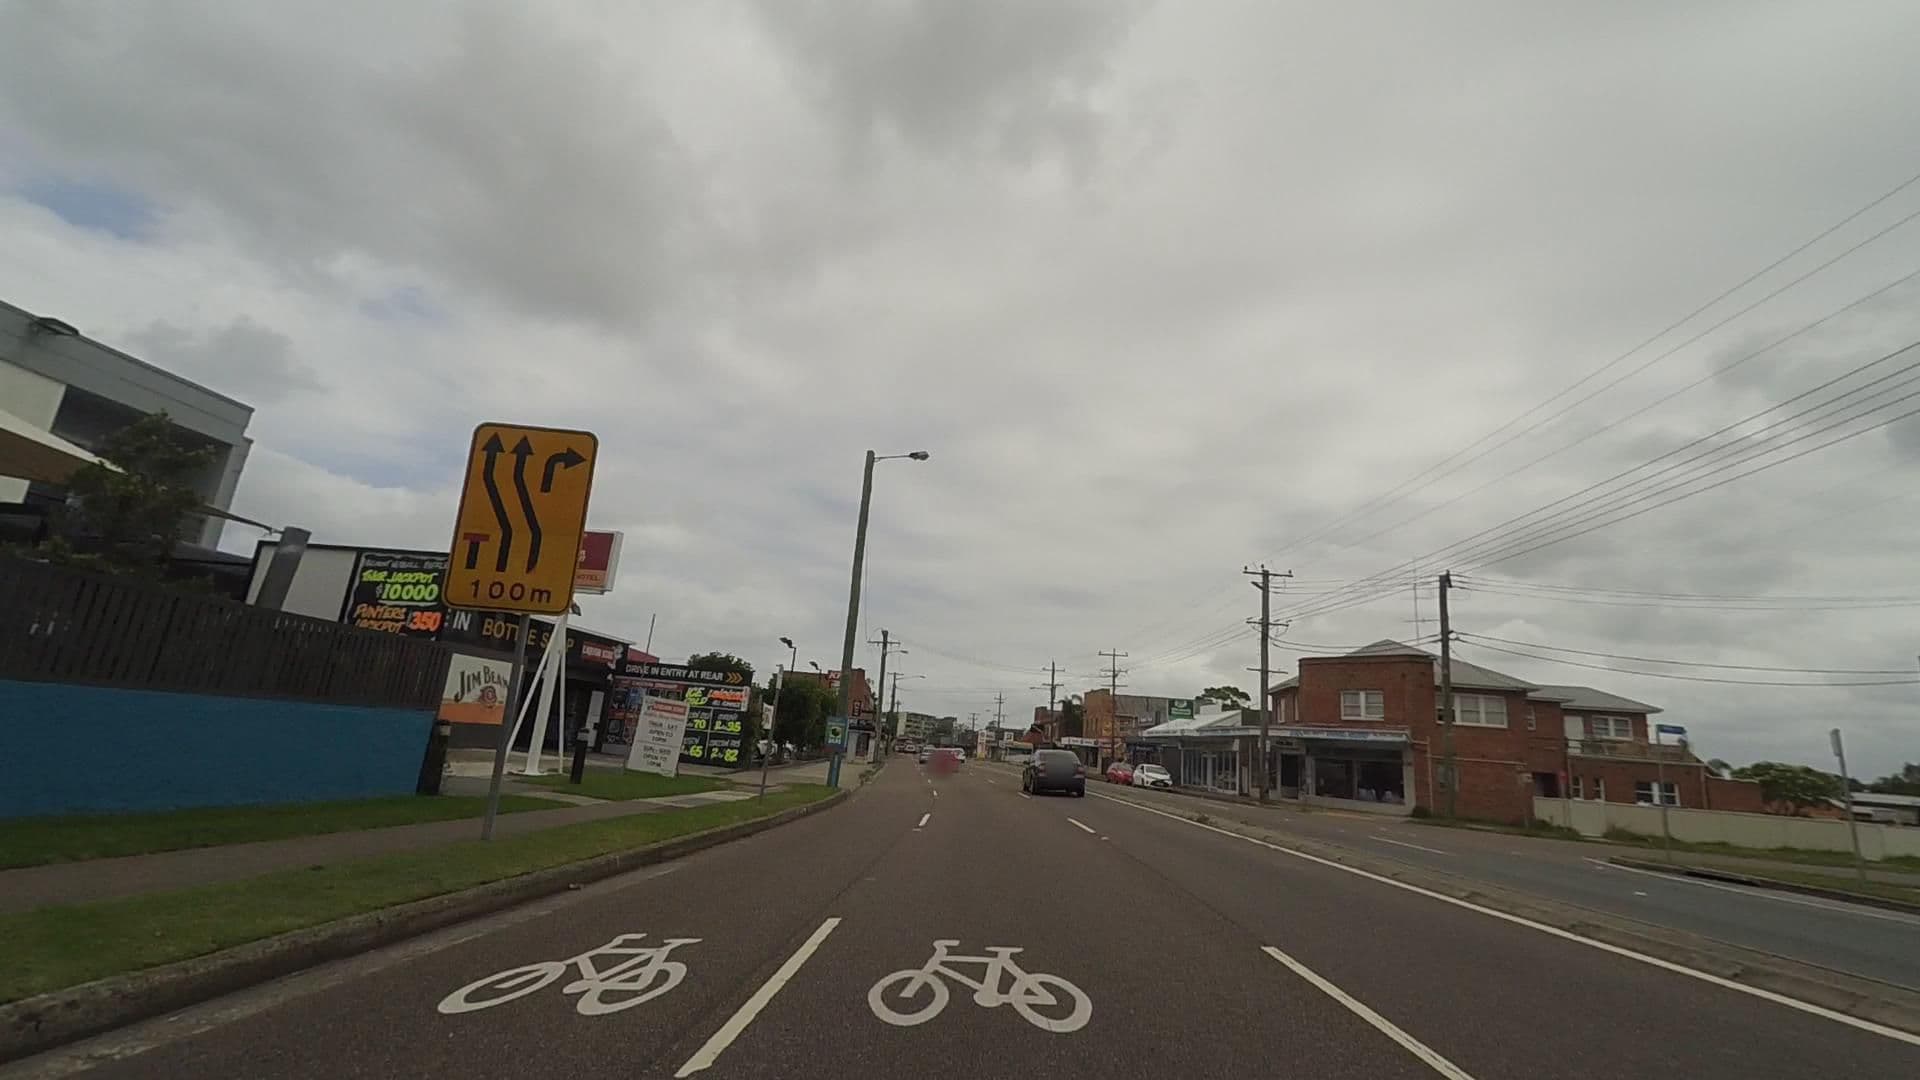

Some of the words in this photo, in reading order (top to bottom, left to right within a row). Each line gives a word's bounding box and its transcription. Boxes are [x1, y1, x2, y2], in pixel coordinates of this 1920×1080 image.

[375, 583, 439, 601] $10000
[471, 579, 552, 603] 100m
[353, 602, 407, 620] PUNTERS
[452, 610, 472, 631] IN
[482, 618, 538, 646] BOTTE
[540, 632, 576, 650] SP
[625, 663, 651, 674] DRIVE
[651, 666, 660, 675] IN
[660, 668, 688, 678] ENTRY
[688, 670, 700, 679] AT
[700, 671, 725, 681] REAR
[454, 669, 481, 703] JIM
